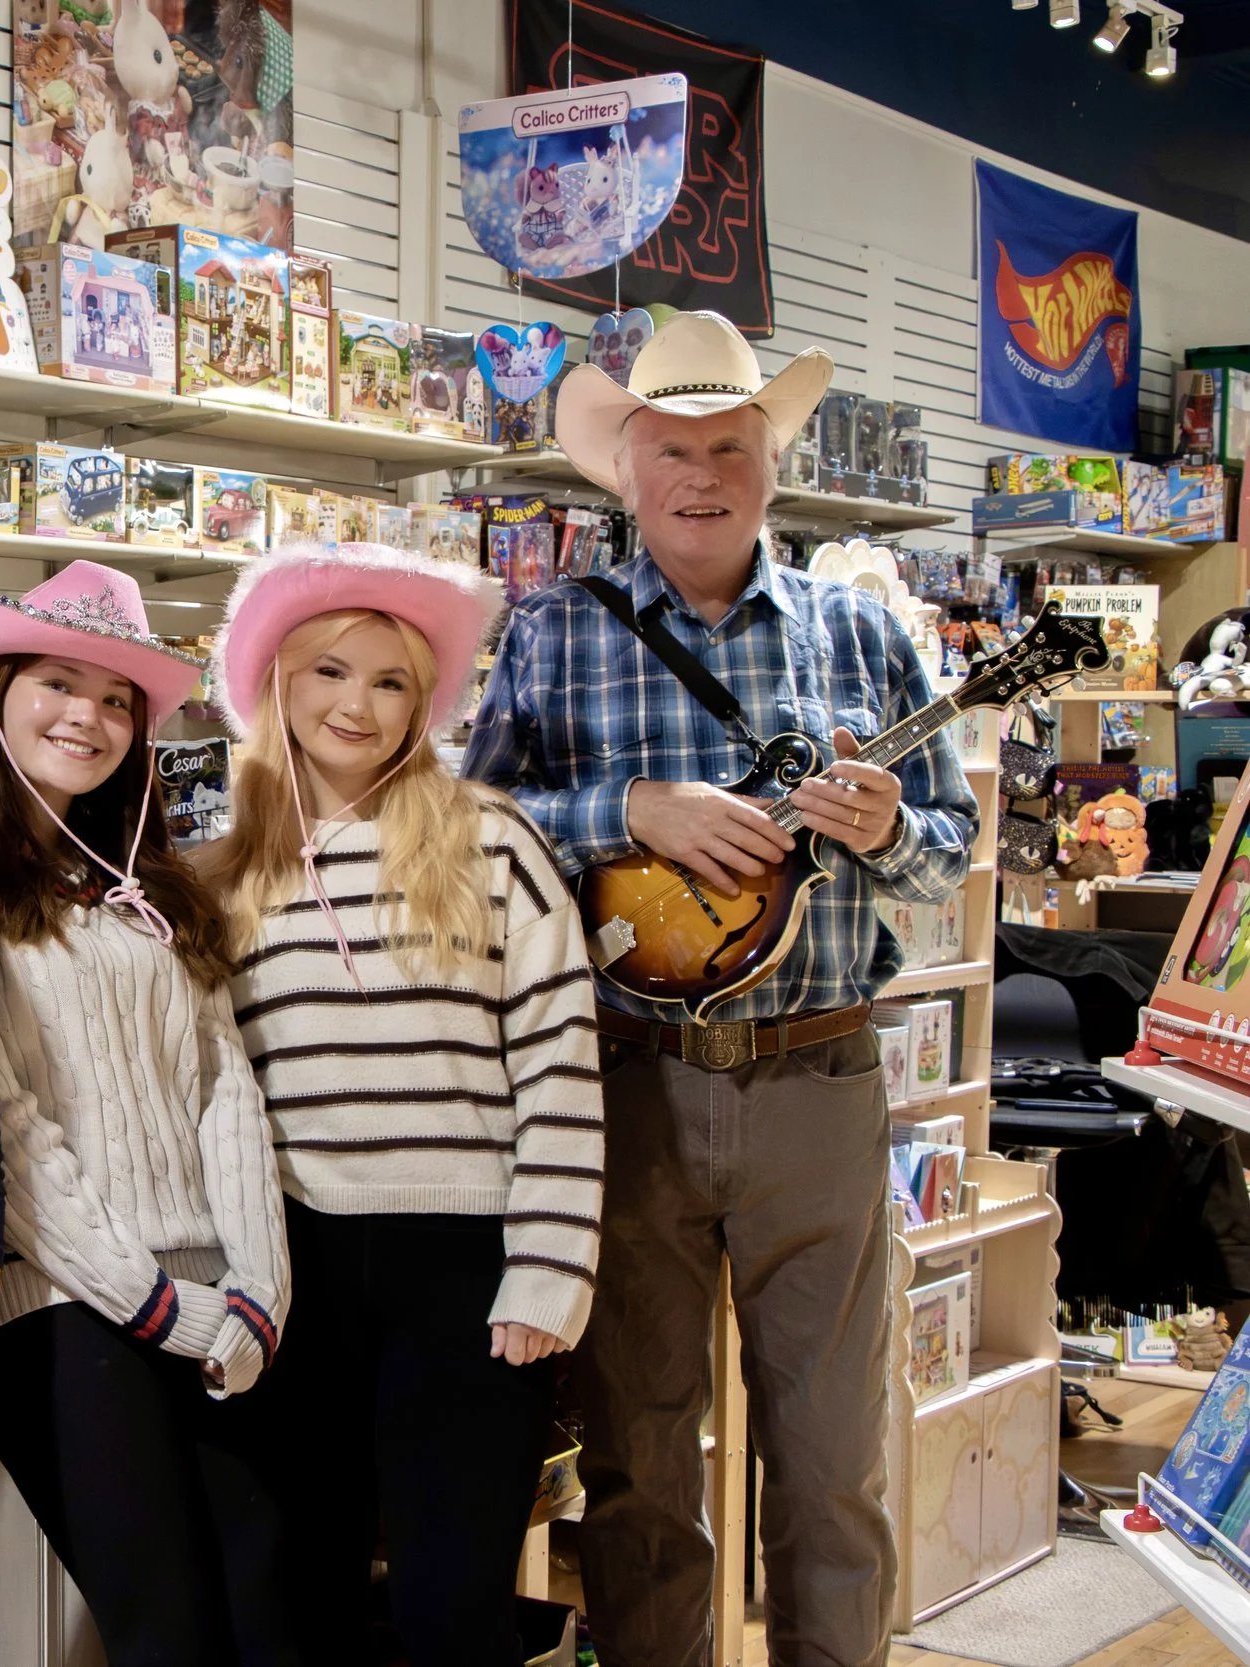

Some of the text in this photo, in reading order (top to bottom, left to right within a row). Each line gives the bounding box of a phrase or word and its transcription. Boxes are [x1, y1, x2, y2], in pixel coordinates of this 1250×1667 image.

[520, 103, 619, 129] Calico Critters
[493, 499, 546, 523] SPIDER-MAN
[1065, 598, 1143, 613] PUMPKIN PROBLEM
[158, 748, 208, 777] Cesar
